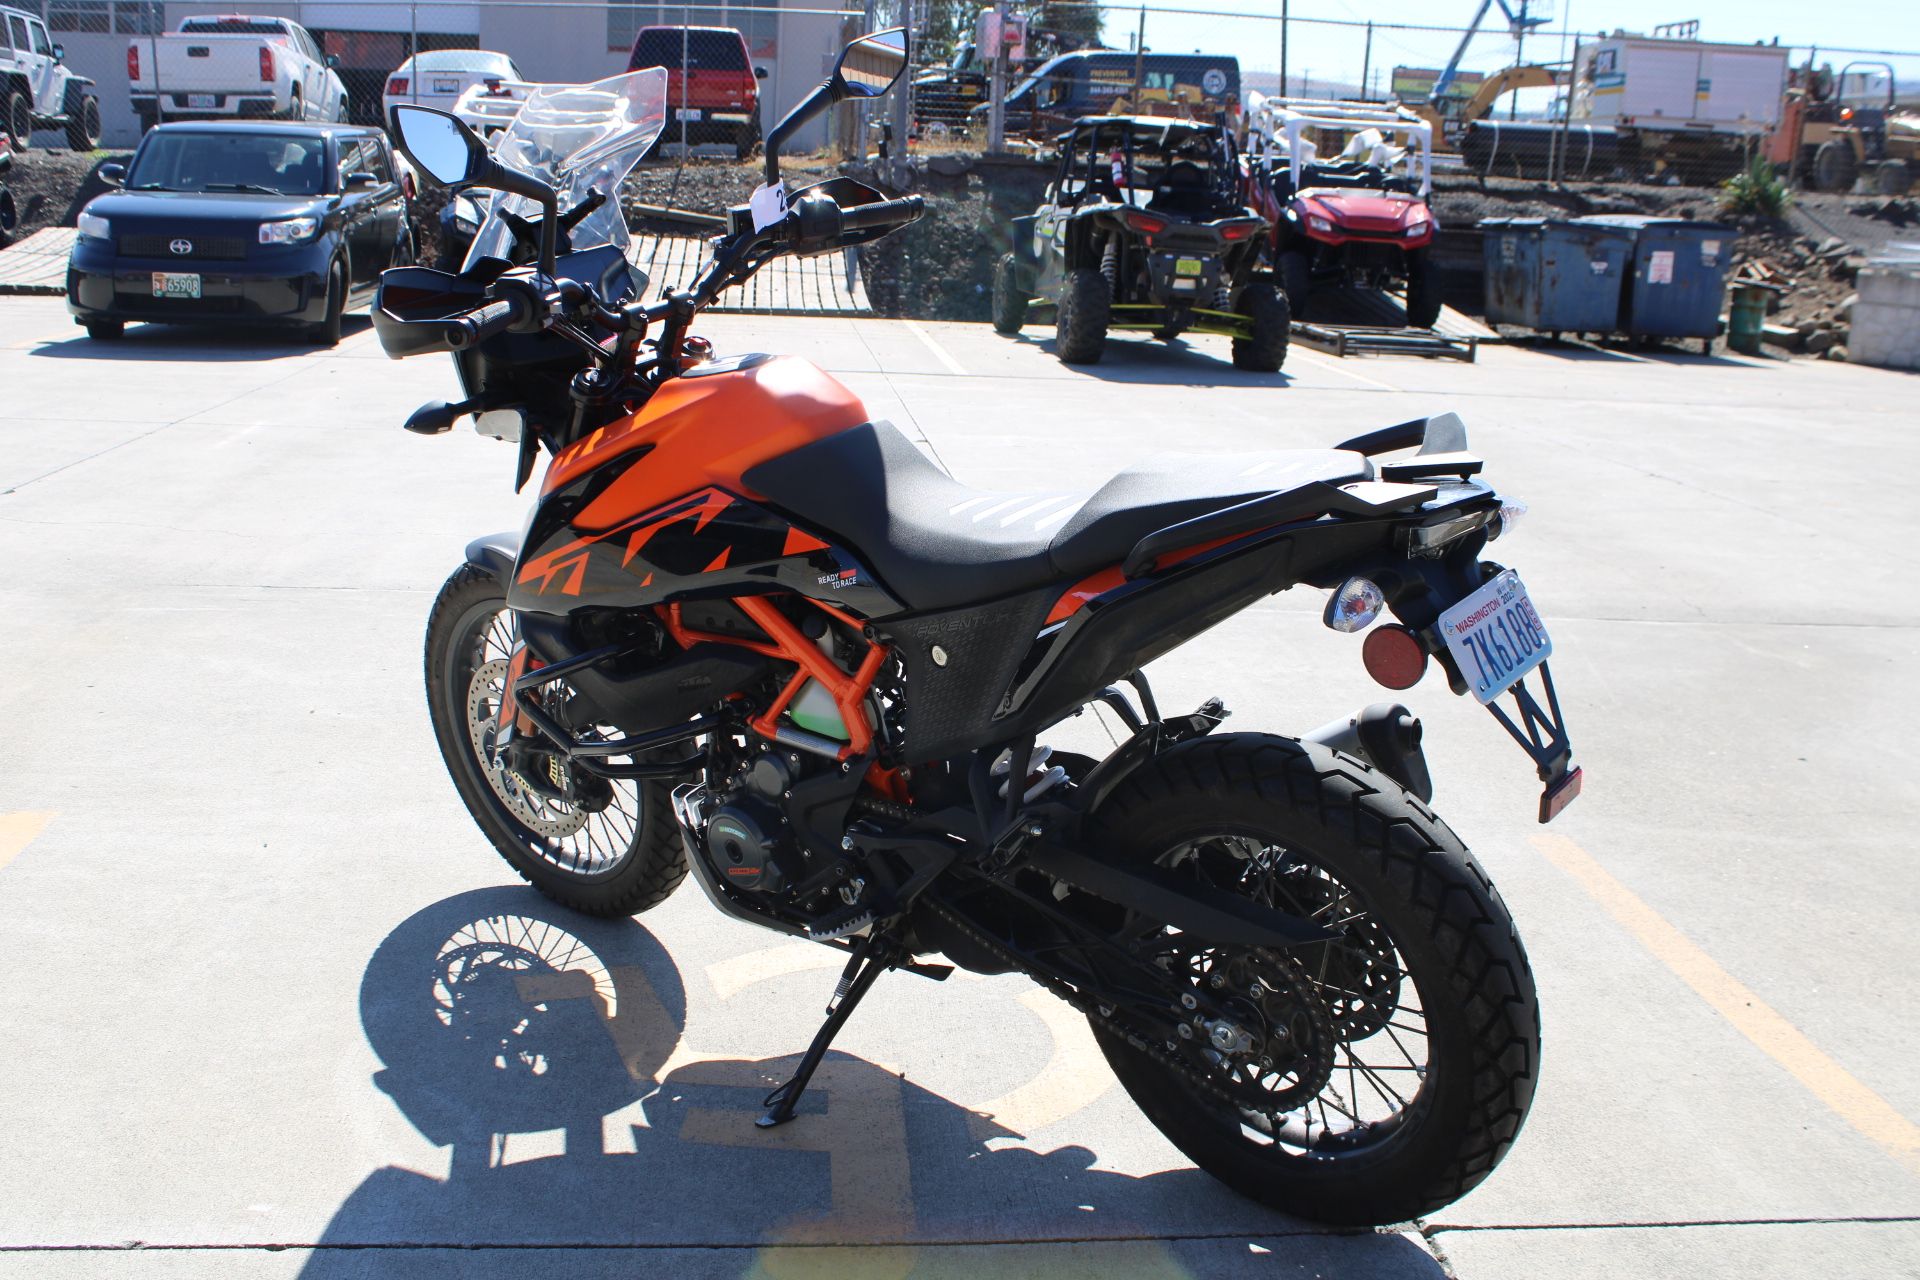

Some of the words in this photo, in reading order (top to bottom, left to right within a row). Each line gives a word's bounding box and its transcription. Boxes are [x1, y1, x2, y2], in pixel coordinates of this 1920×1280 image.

[817, 572, 840, 585] READY
[831, 581, 841, 590] TO
[840, 576, 857, 587] RACE
[1455, 598, 1501, 634] WASHINGTON
[1462, 602, 1543, 689] 7K6188
